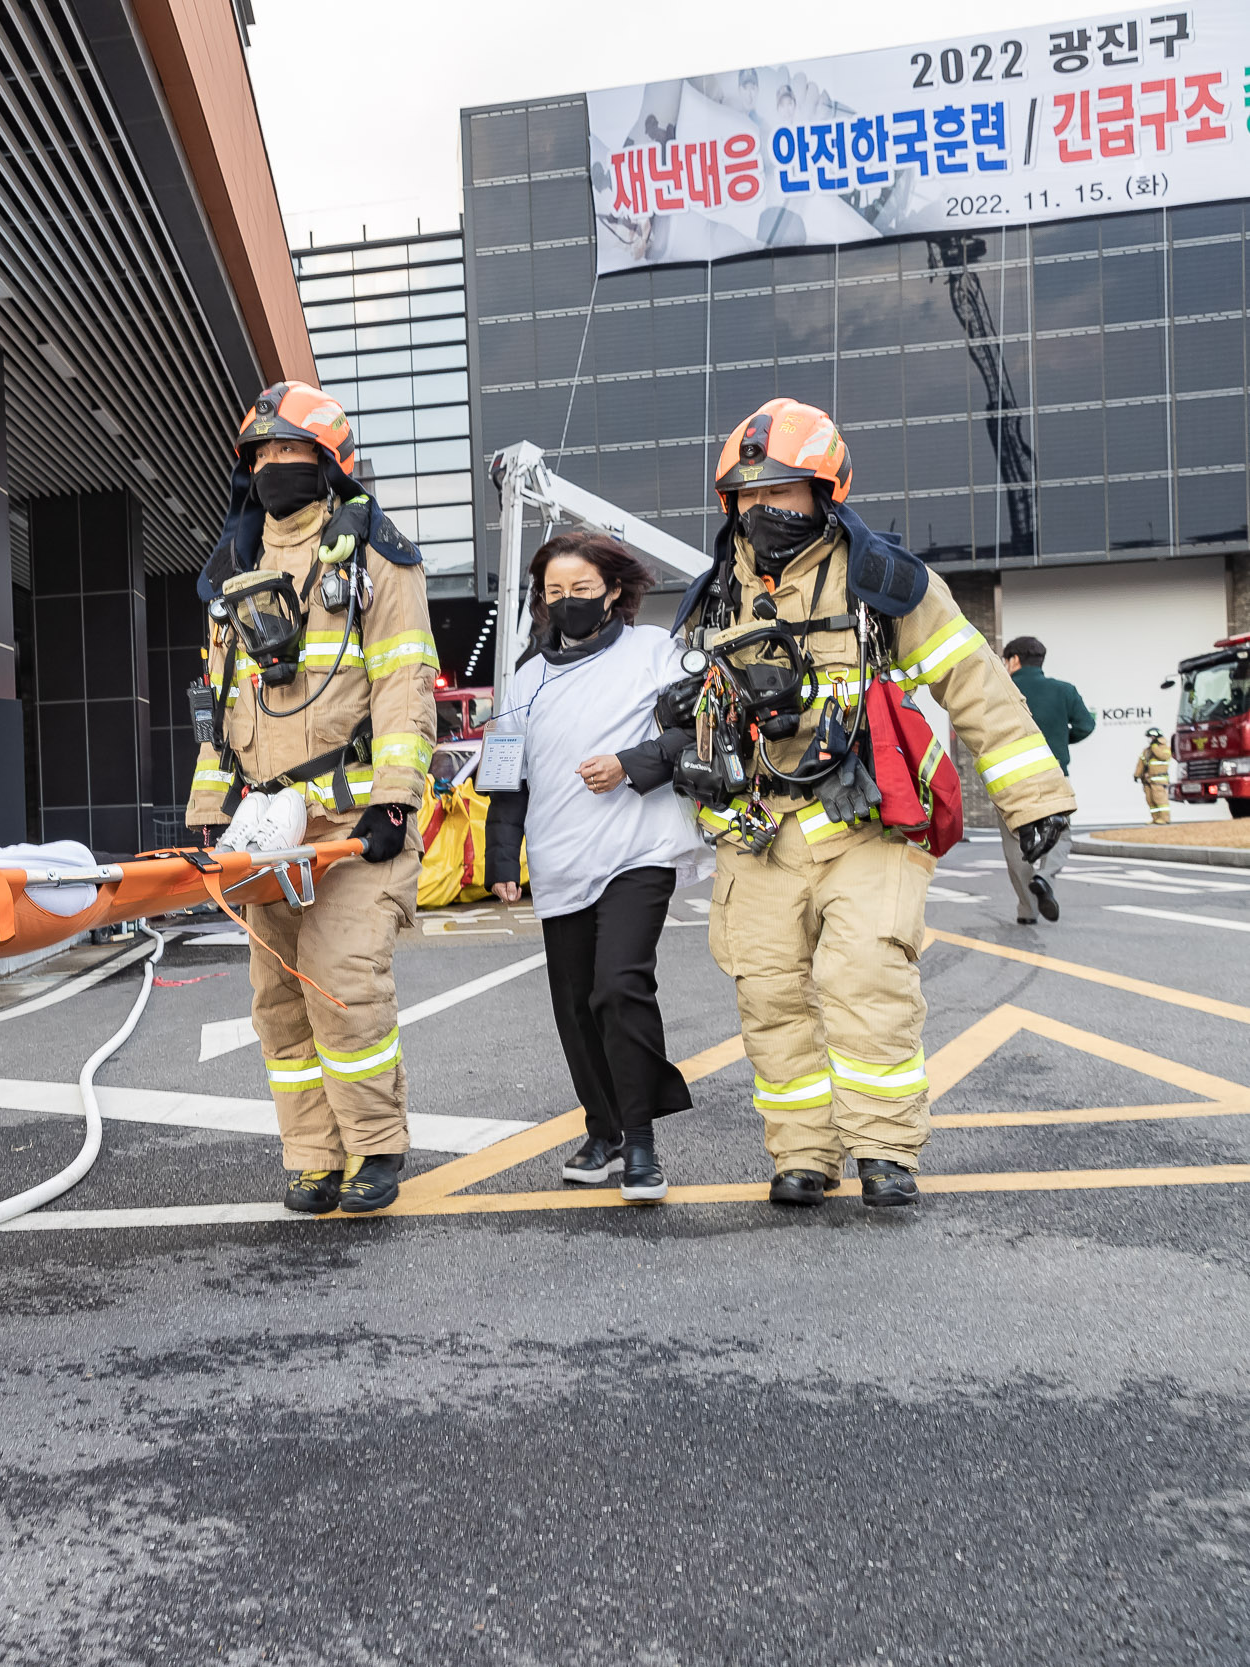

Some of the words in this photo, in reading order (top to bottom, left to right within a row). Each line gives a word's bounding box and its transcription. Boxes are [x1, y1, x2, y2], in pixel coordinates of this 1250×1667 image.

[910, 40, 1023, 89] 2022
[1049, 12, 1190, 74] 광진구
[610, 134, 760, 215] 재난대응
[772, 101, 1008, 194] 안전한국훈련
[1053, 72, 1227, 163] 긴급구조
[945, 194, 1010, 217] 2022.
[1024, 190, 1060, 209] 11.
[1075, 182, 1111, 202] 15.
[1125, 173, 1169, 201] (화)
[1102, 706, 1152, 720] KOFIH
